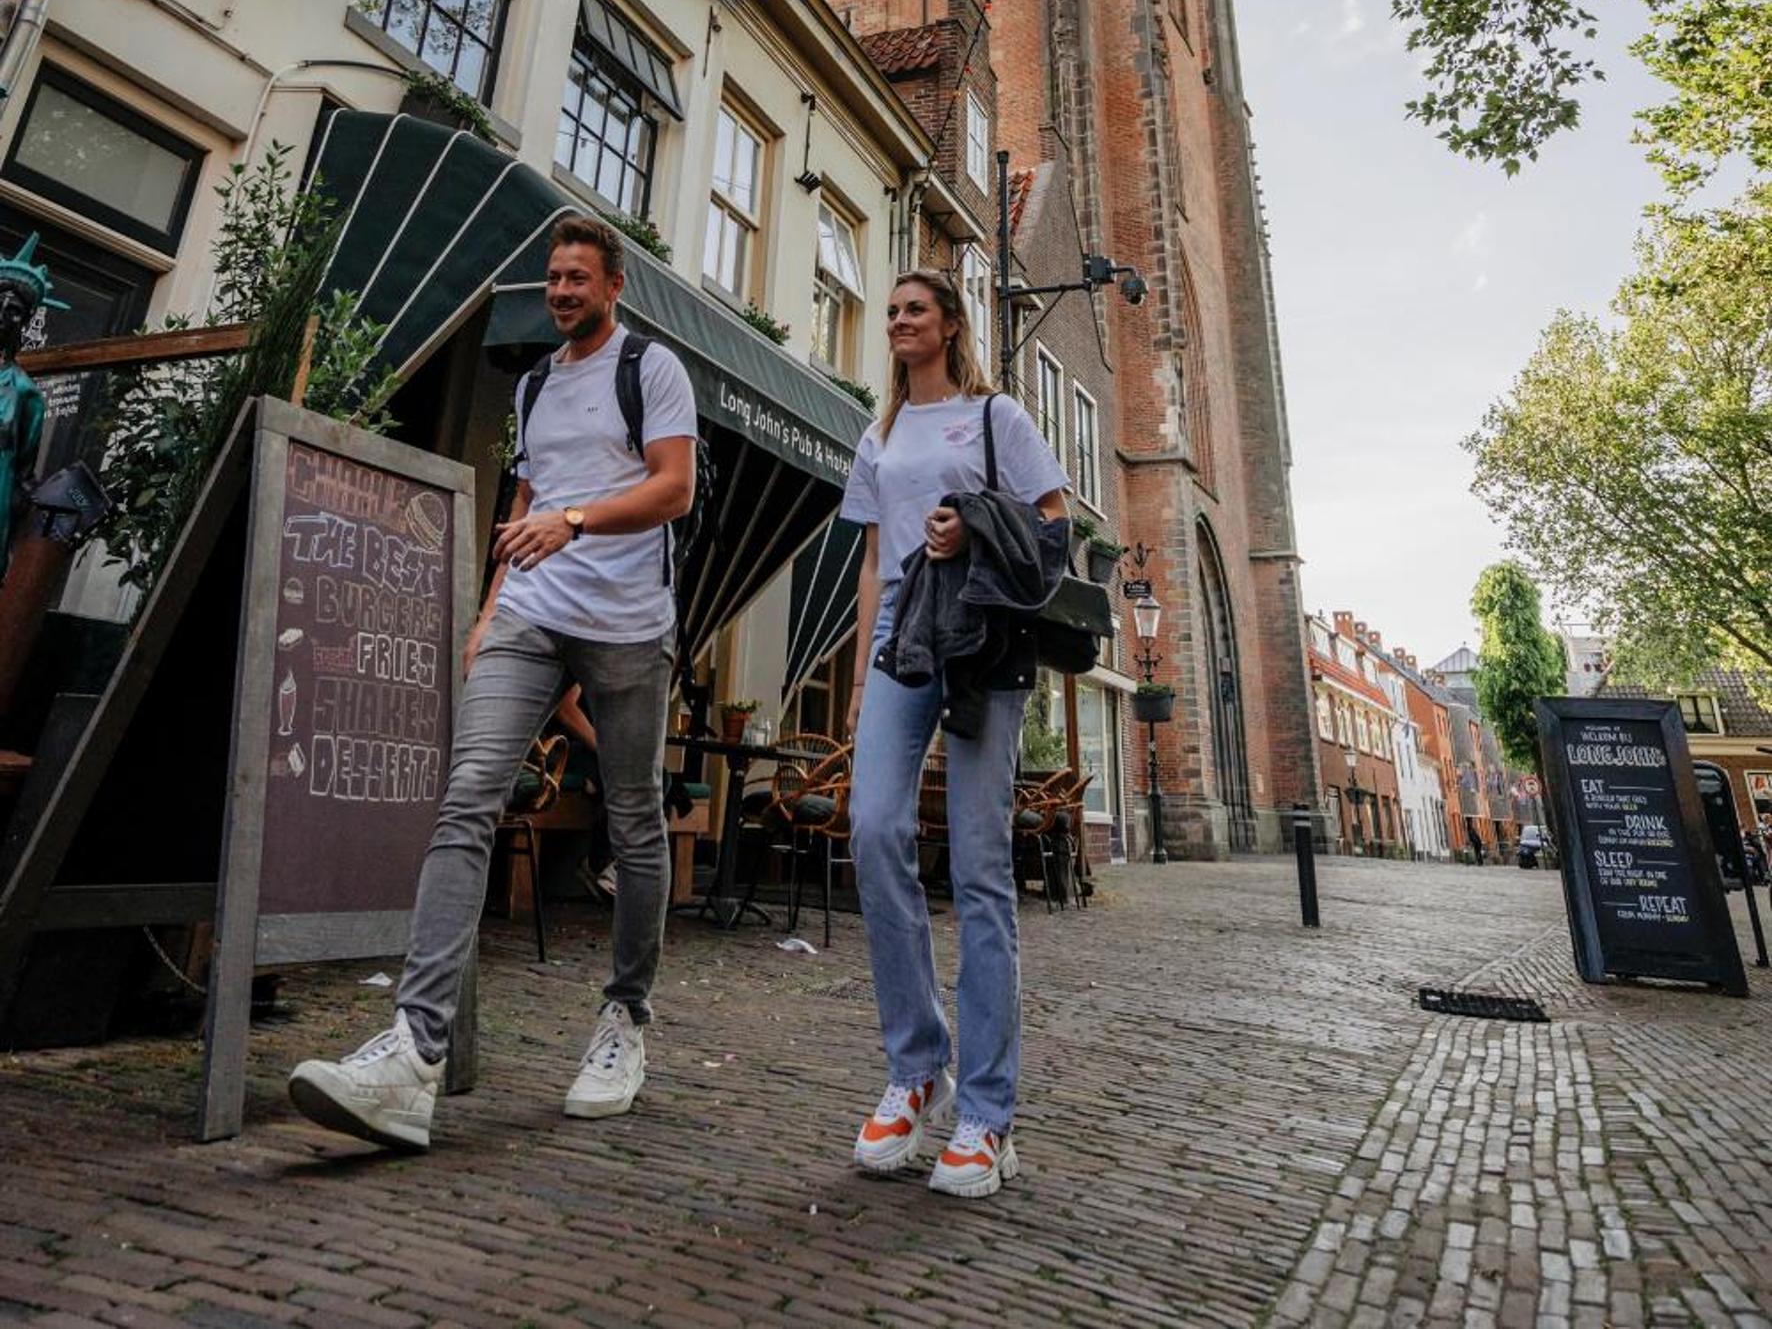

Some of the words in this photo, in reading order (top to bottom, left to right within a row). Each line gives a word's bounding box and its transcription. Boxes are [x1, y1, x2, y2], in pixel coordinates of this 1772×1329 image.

[720, 382, 751, 425] Long
[753, 404, 790, 445] John's
[791, 426, 813, 457] Pub
[814, 440, 823, 464] &
[825, 446, 852, 477] Hotel
[283, 510, 358, 569] THE
[362, 525, 444, 599] BEST
[315, 574, 443, 642] BURGERS
[356, 631, 438, 689] FRIES
[312, 675, 441, 745] SHAKES
[309, 733, 441, 803] DESSERTS
[1580, 778, 1605, 794] EAT
[1625, 814, 1669, 831] DRINK
[1593, 849, 1633, 869] SLEEP
[1639, 894, 1688, 915] REPEAT
